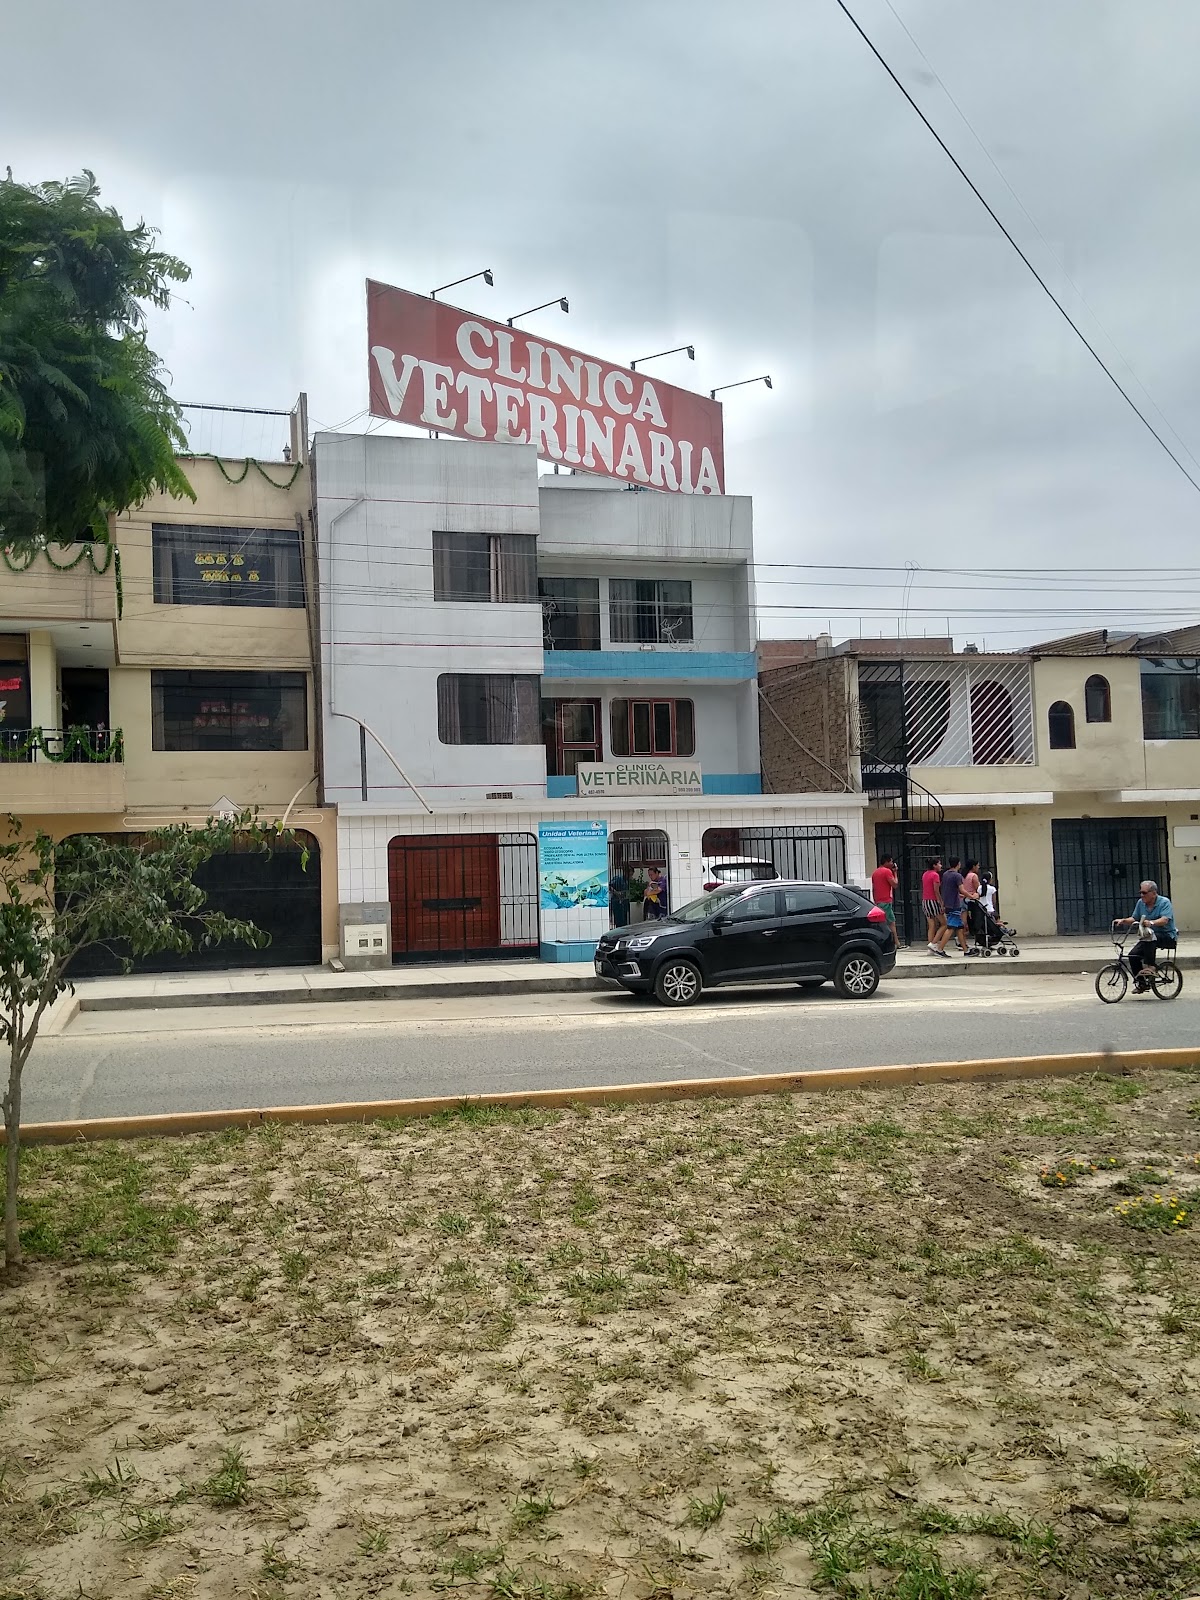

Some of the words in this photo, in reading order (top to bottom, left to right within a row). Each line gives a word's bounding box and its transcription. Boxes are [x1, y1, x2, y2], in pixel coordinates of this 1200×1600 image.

[456, 320, 668, 428] CLINICA
[370, 345, 722, 495] VETERINARIA
[580, 770, 701, 786] VETERINARIA
[567, 829, 604, 837] Veterinaria
